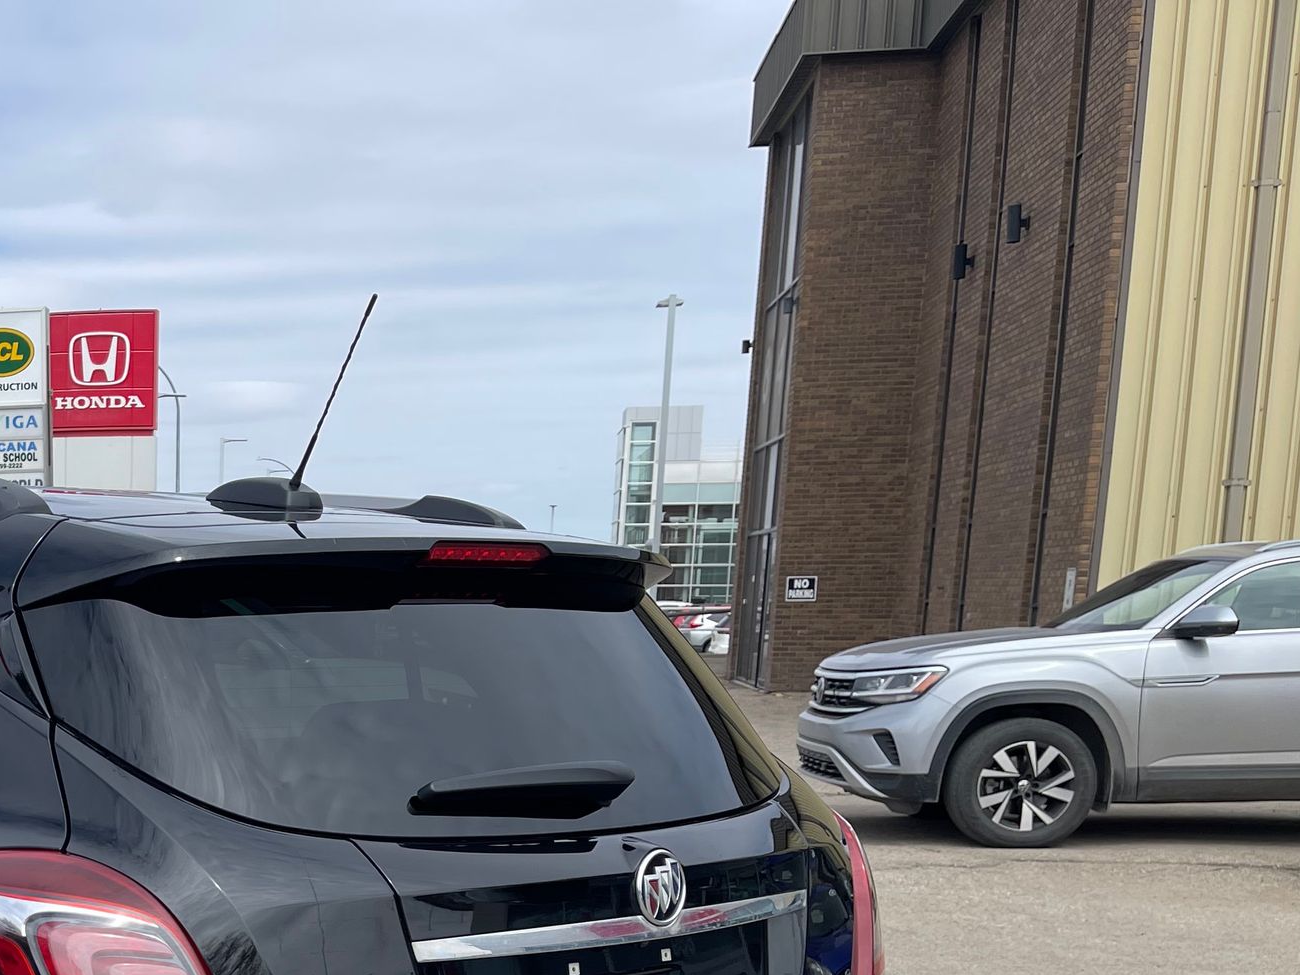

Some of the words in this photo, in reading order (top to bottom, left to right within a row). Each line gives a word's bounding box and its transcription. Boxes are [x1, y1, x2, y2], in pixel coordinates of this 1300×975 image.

[54, 395, 146, 410] HONDA
[3, 452, 38, 463] SCHOOL
[793, 578, 810, 589] NO
[788, 589, 814, 599] PARKING
